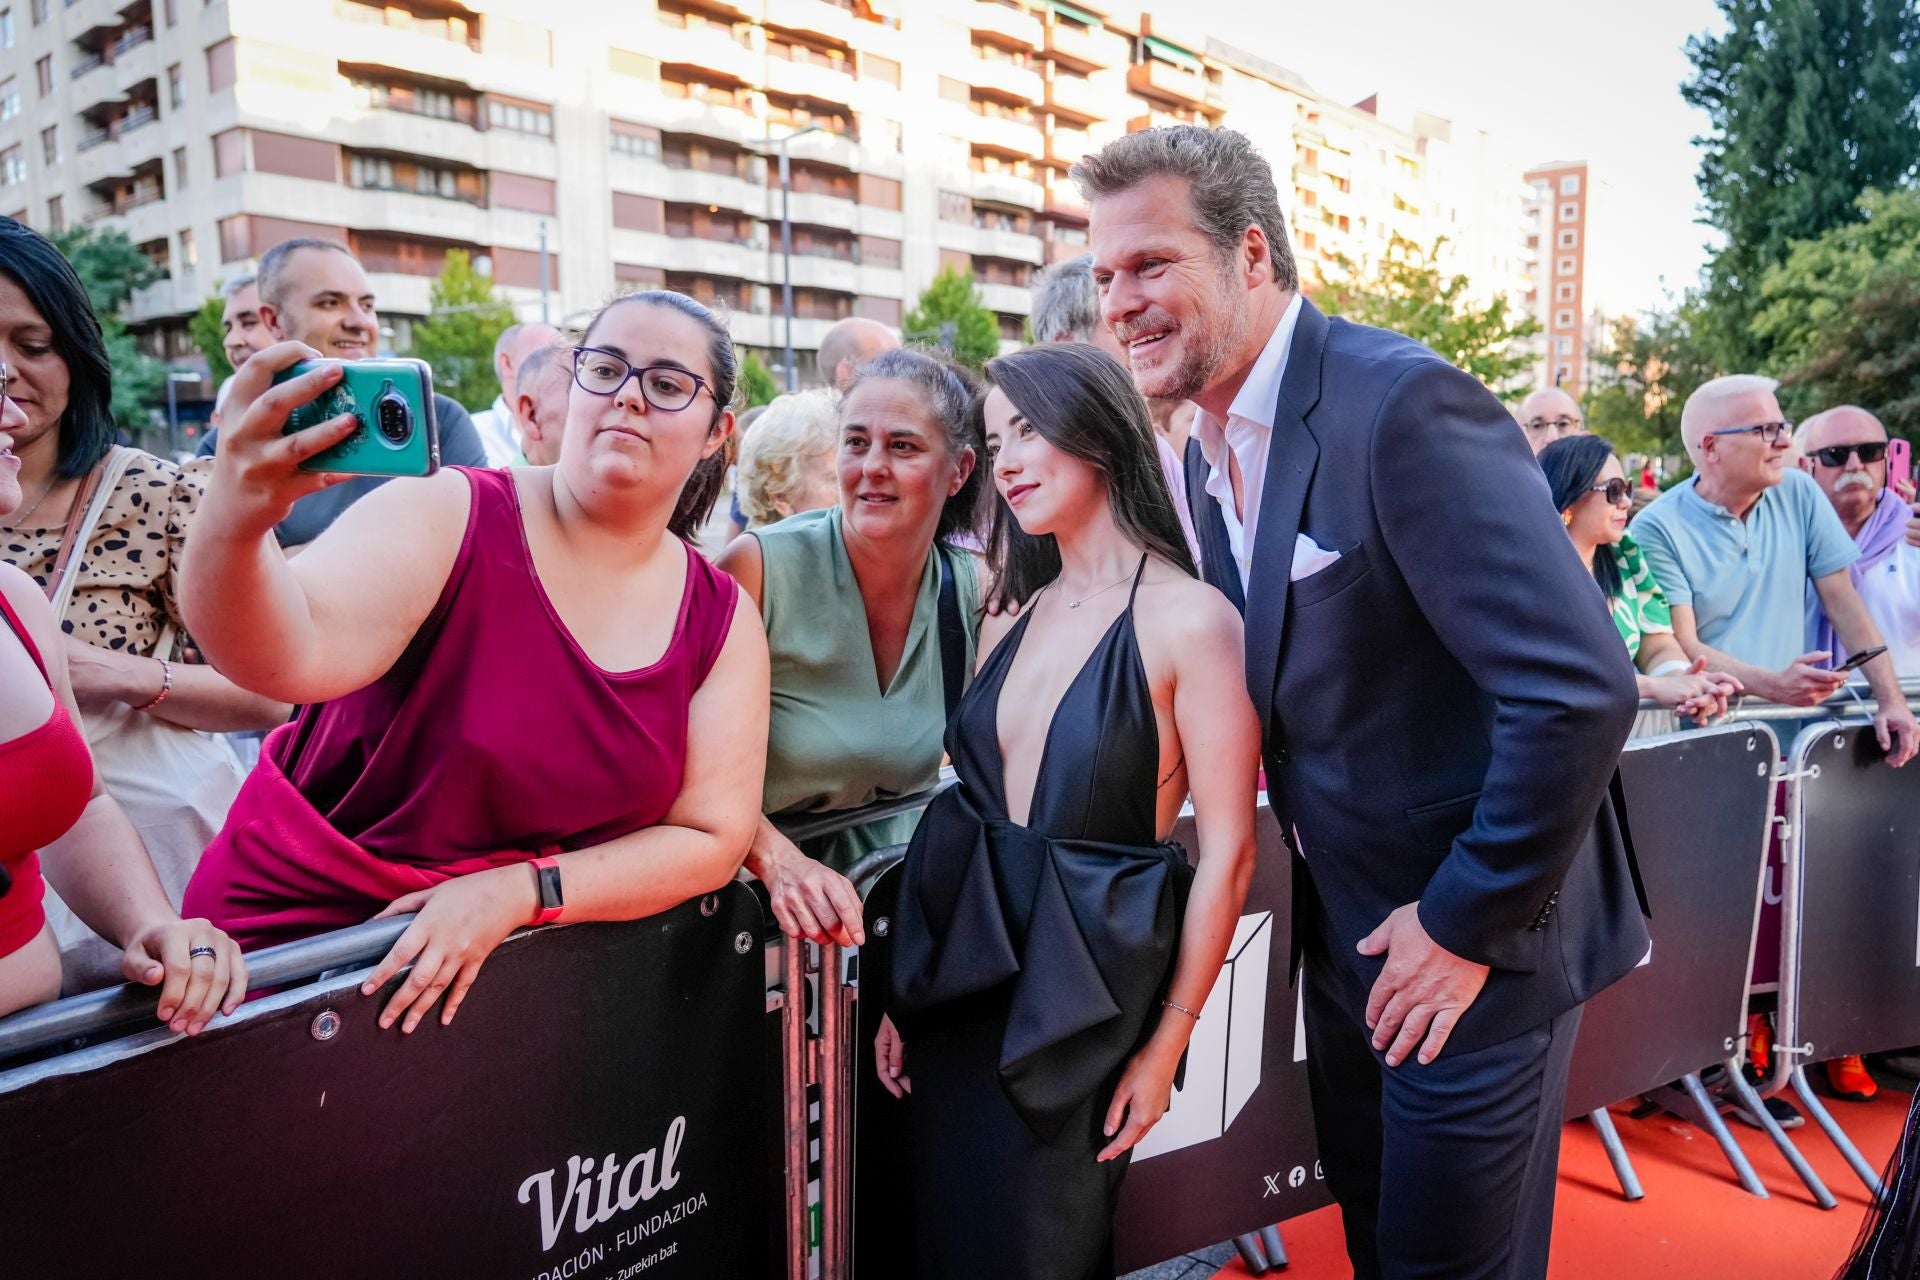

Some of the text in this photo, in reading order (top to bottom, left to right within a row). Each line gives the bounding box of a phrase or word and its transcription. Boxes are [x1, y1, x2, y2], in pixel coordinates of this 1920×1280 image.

[518, 1115, 686, 1251] Vital
[616, 1192, 708, 1252] FUNDAZIOA
[660, 1242, 678, 1261] bat
